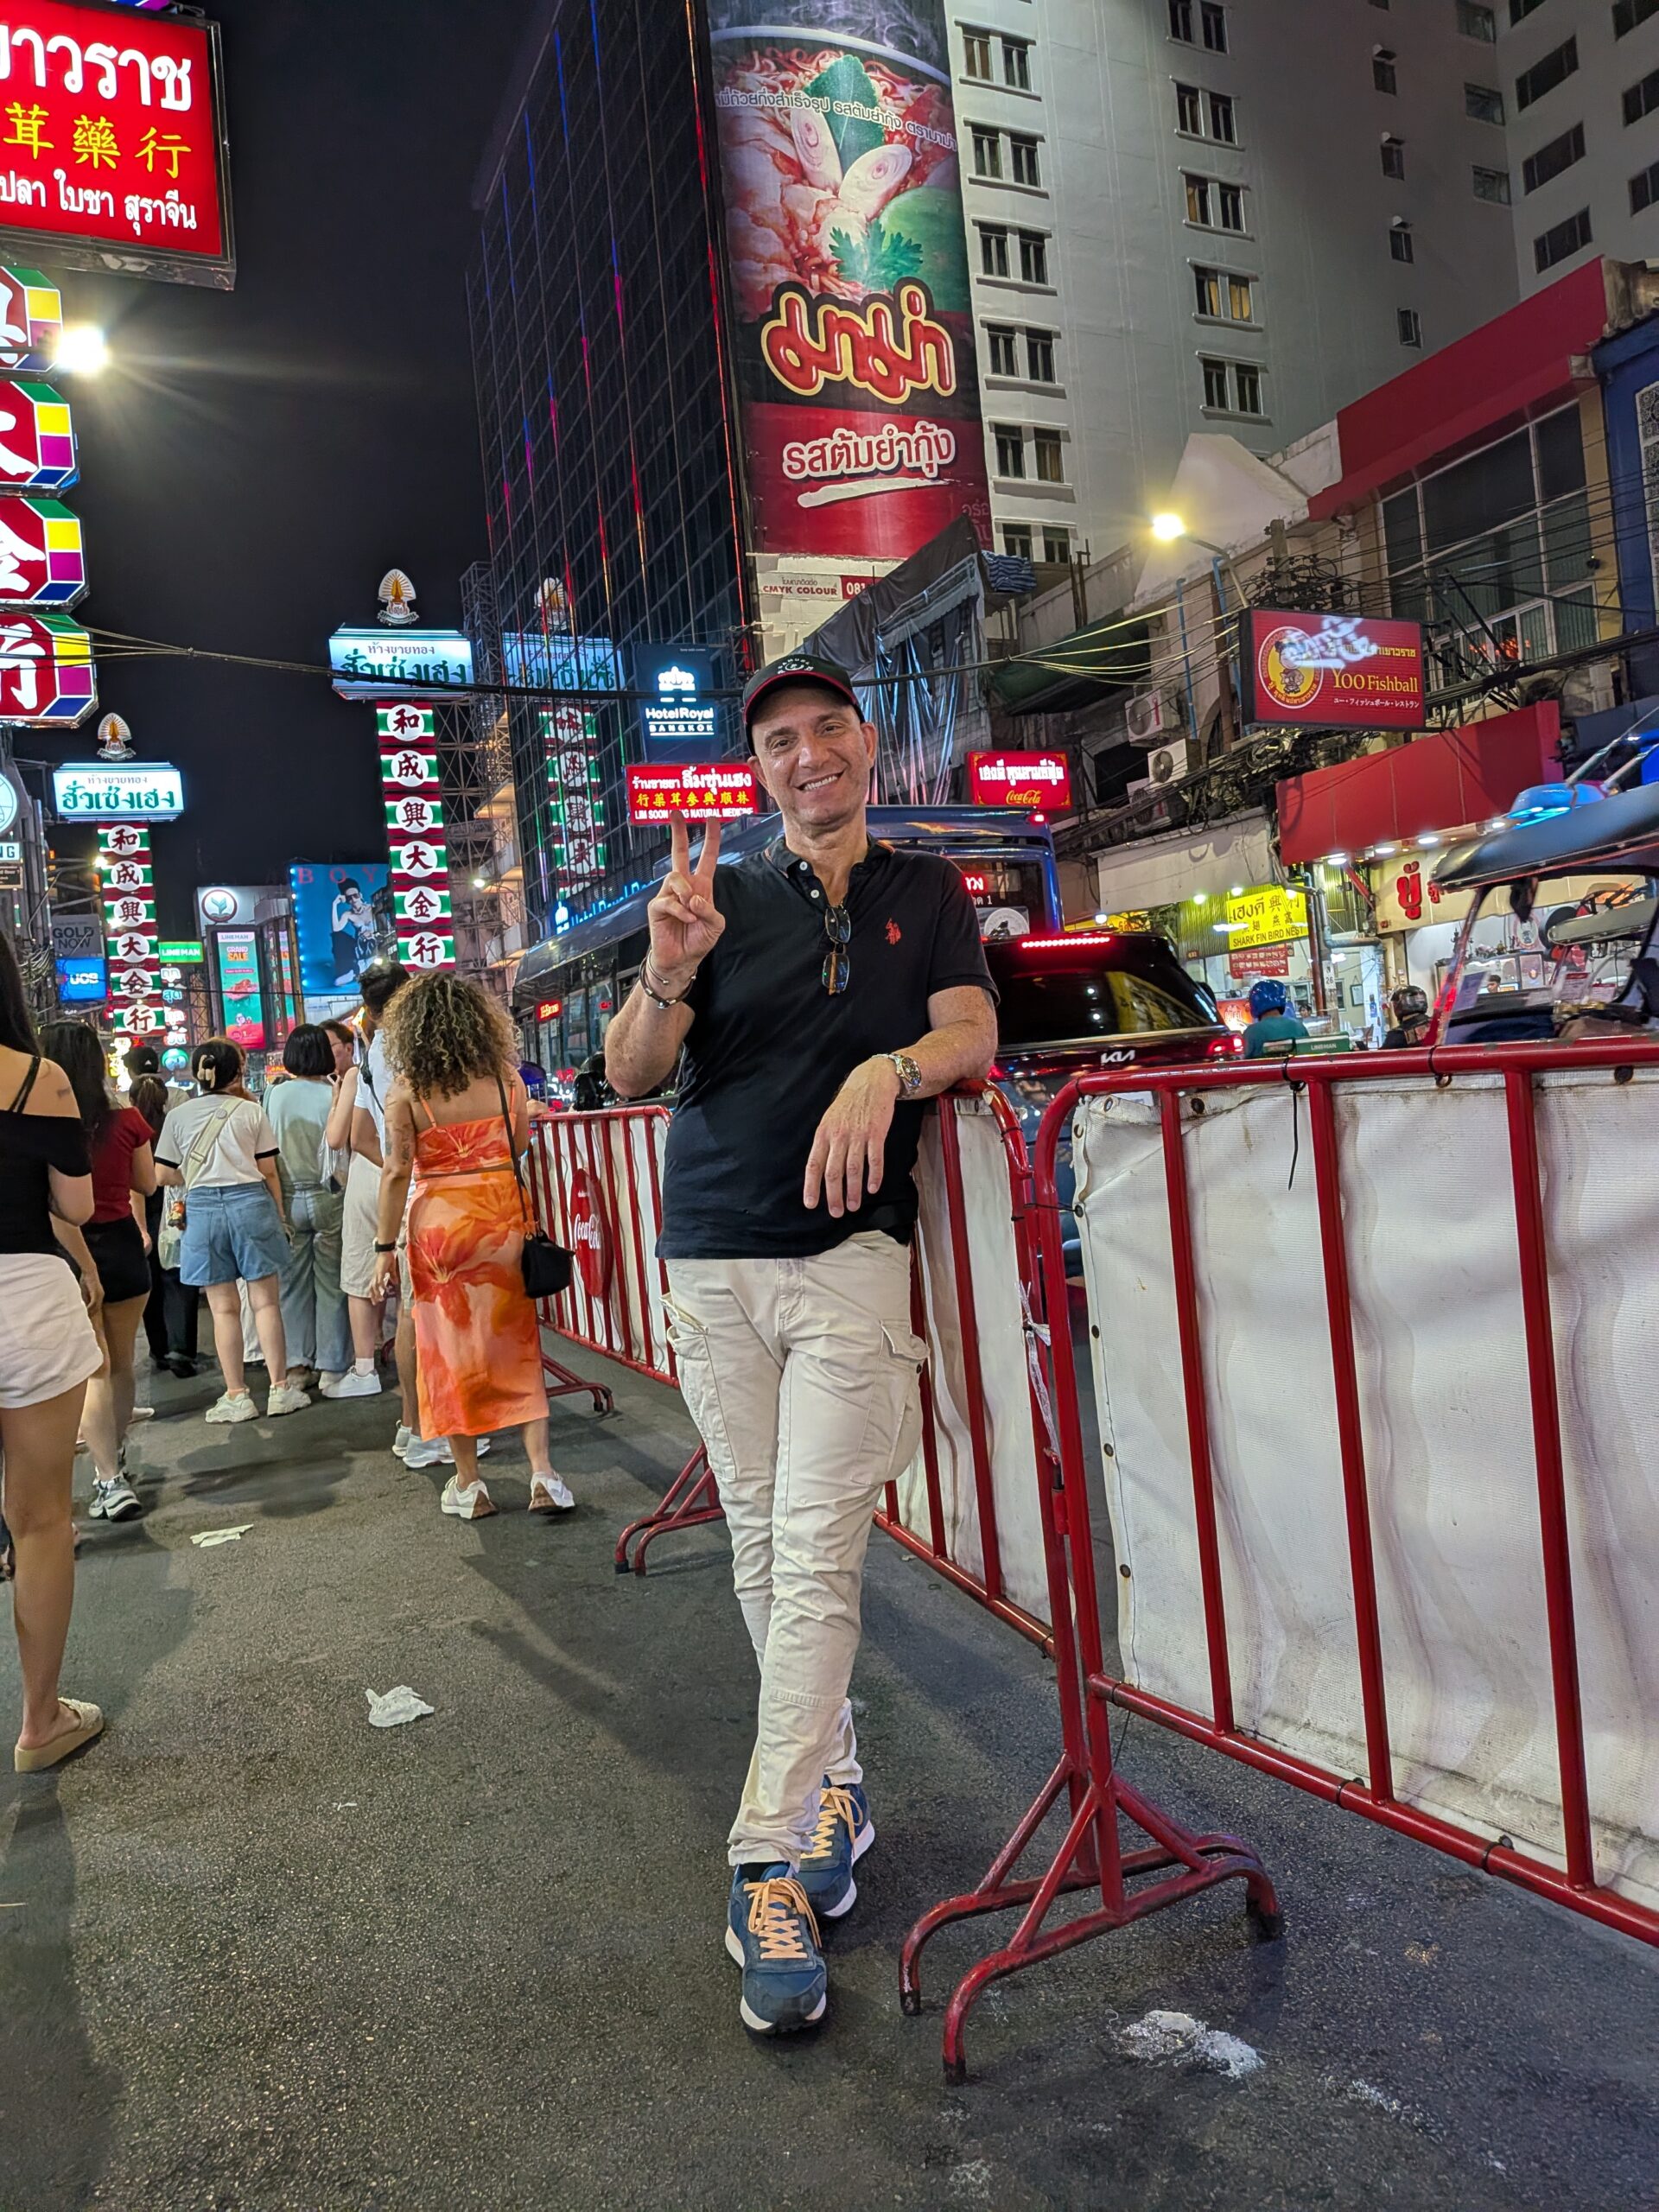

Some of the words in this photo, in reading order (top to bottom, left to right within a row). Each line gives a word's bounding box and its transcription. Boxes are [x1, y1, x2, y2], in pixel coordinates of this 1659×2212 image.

[54, 168, 114, 218] ใบชา
[124, 189, 198, 236] สุราจีน
[761, 284, 957, 404] มาม่า
[785, 423, 955, 478] รสต้มยำกุ้ง
[762, 586, 792, 594] CMYK
[797, 587, 838, 596] COLOUR
[368, 642, 435, 654] ห้างขายทอง
[1332, 667, 1365, 690] YOO
[1368, 674, 1419, 693] Fishball
[645, 709, 678, 720] Hotel
[679, 708, 714, 721] Royal
[62, 780, 175, 810] ฮั่วเซ่งเฮง
[648, 809, 669, 820] SOON
[690, 809, 722, 819] NATURAL
[987, 895, 993, 905] 1
[53, 926, 94, 939] GOLD
[1233, 934, 1255, 948] SHARK
[1255, 931, 1267, 943] FIN
[1268, 929, 1285, 941] BIRD
[1286, 925, 1304, 938] NEST
[59, 938, 91, 950] NOW
[227, 952, 248, 961] SALE
[69, 972, 99, 985] UOB
[1325, 976, 1334, 984] 26
[1100, 1050, 1135, 1064] KIA
